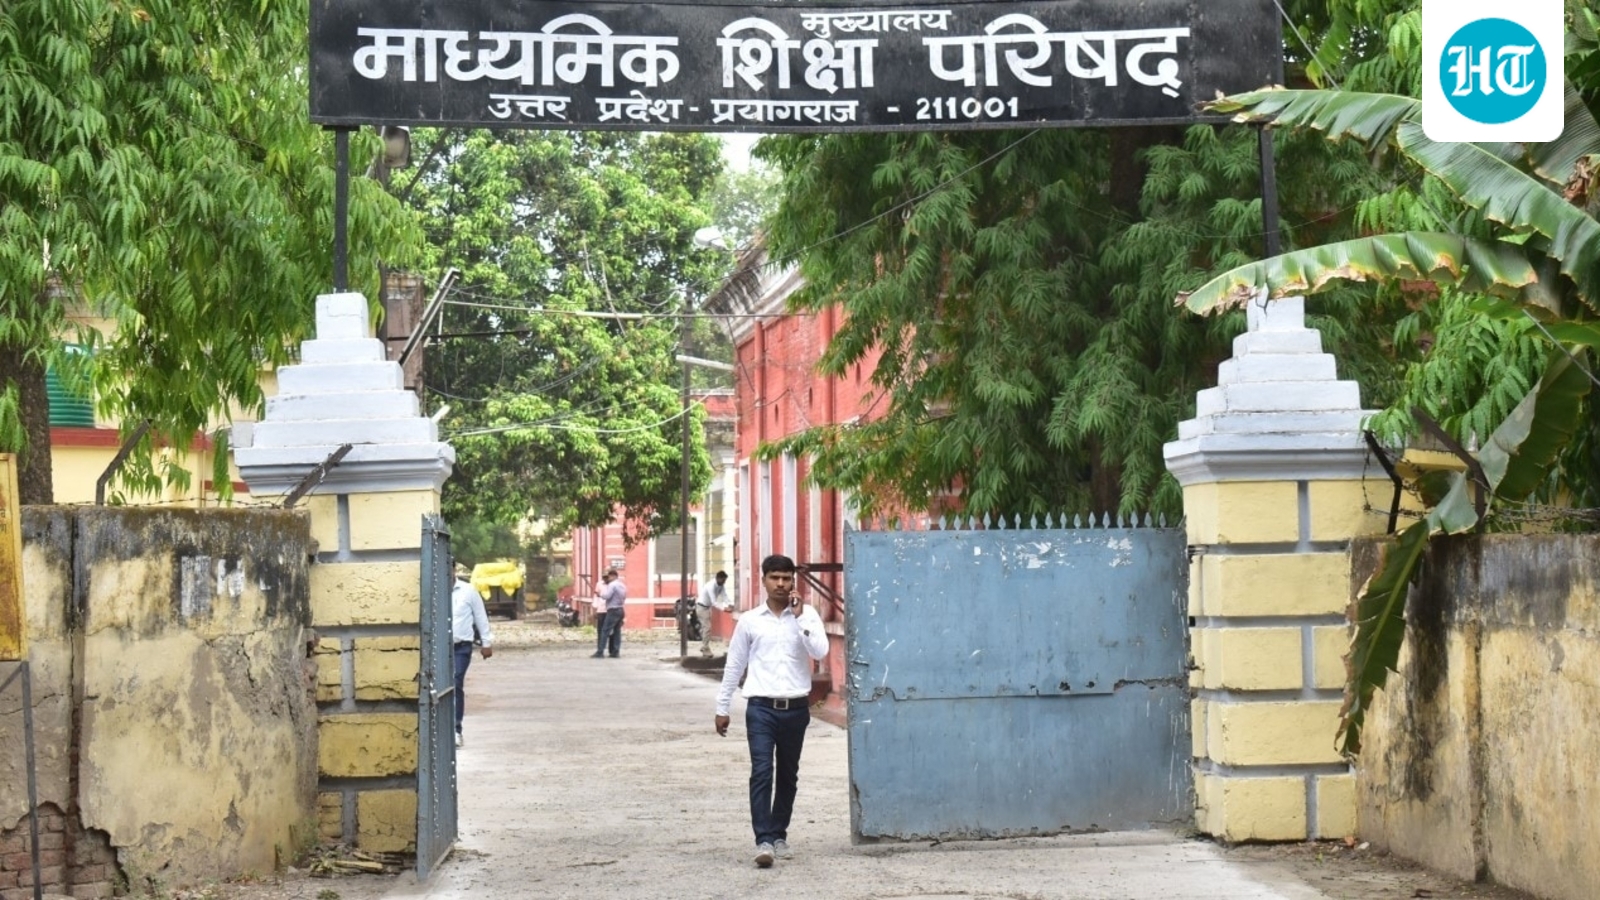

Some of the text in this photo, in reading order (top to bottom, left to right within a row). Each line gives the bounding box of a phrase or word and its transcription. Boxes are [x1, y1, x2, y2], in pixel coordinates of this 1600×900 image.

[801, 8, 953, 38] मुख्यालय
[353, 13, 1191, 98] माध्यमिक शिक्षा परिषद्
[488, 93, 571, 120] उत्तर
[595, 90, 684, 123] प्रदेश
[710, 98, 859, 125] प्रयागराज
[916, 96, 1019, 120] 211001
